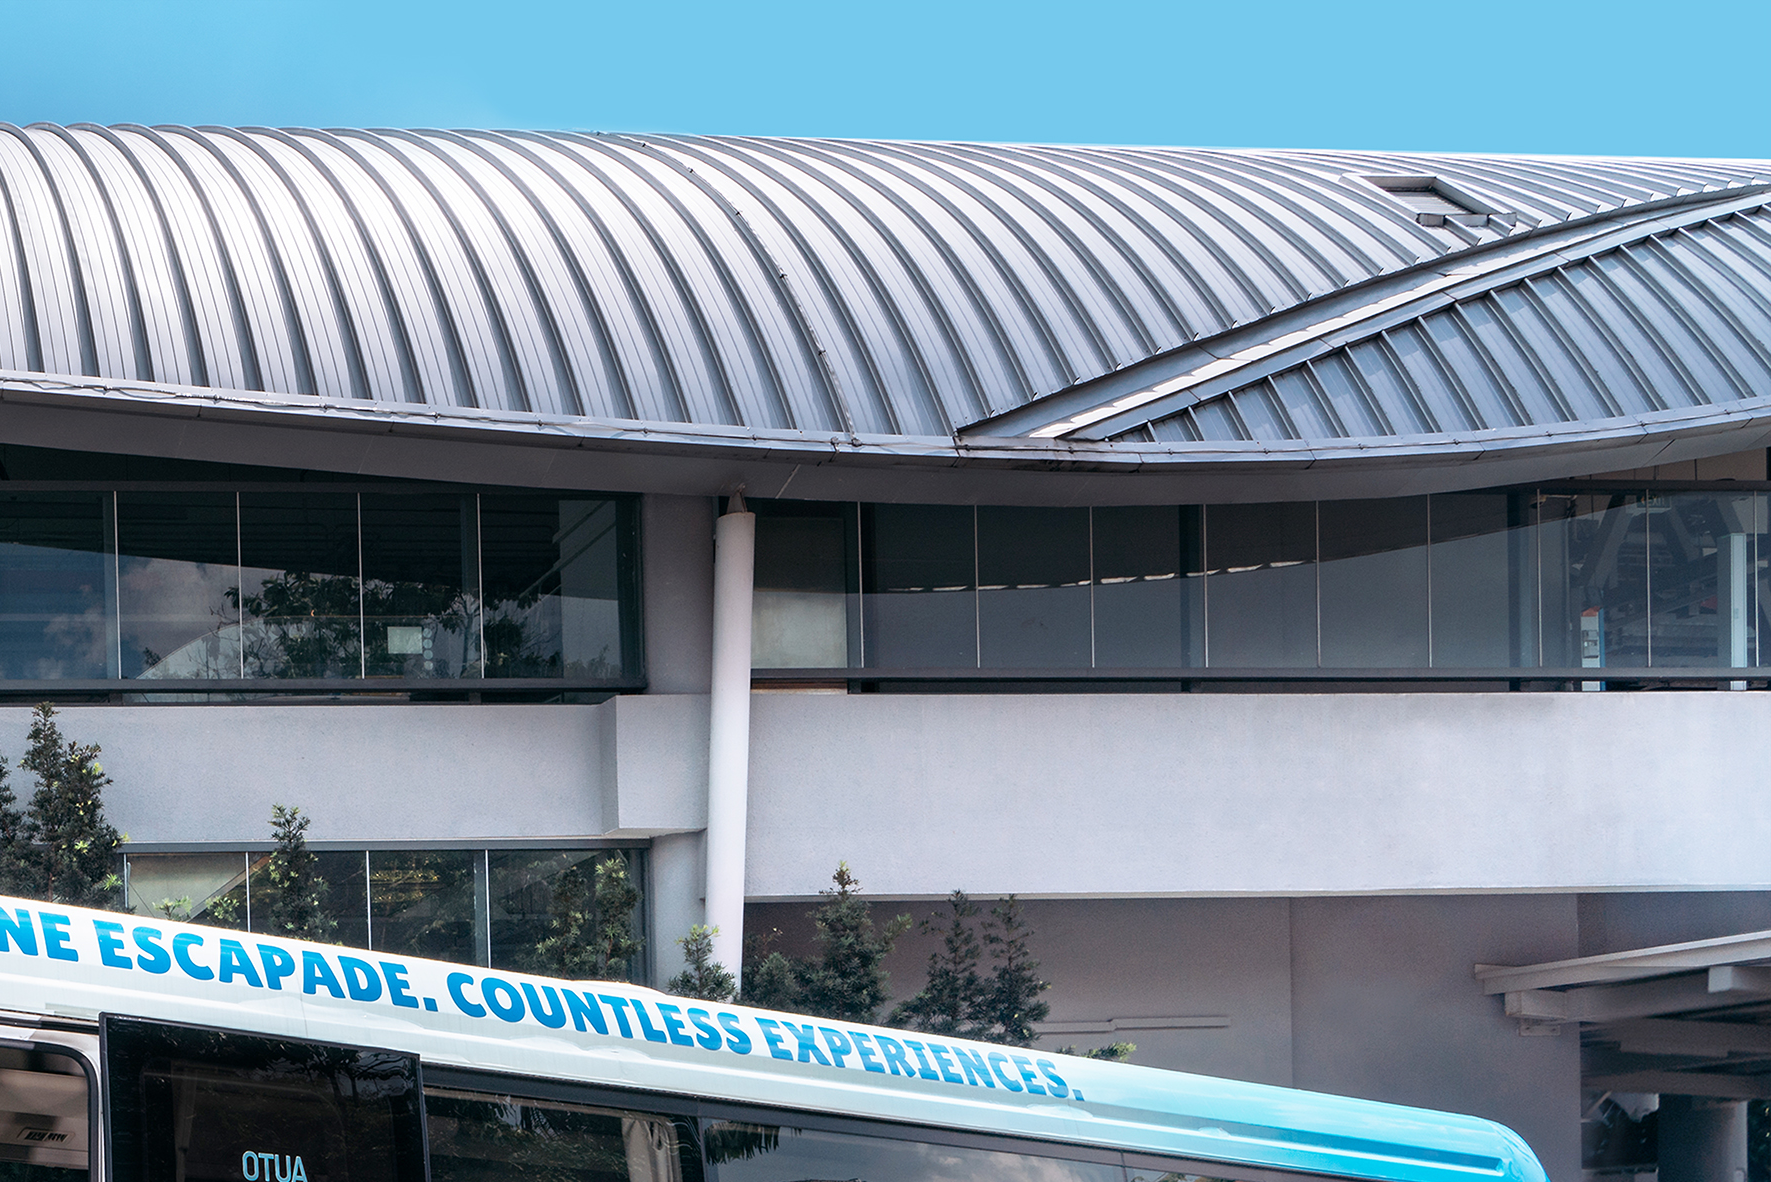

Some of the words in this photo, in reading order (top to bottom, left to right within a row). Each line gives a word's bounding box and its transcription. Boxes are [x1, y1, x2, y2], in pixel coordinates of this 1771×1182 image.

[93, 920, 438, 1012] ESCAPADE.
[447, 972, 751, 1054] COUNTLESS
[755, 1017, 1085, 1101] EXPERIENCES.
